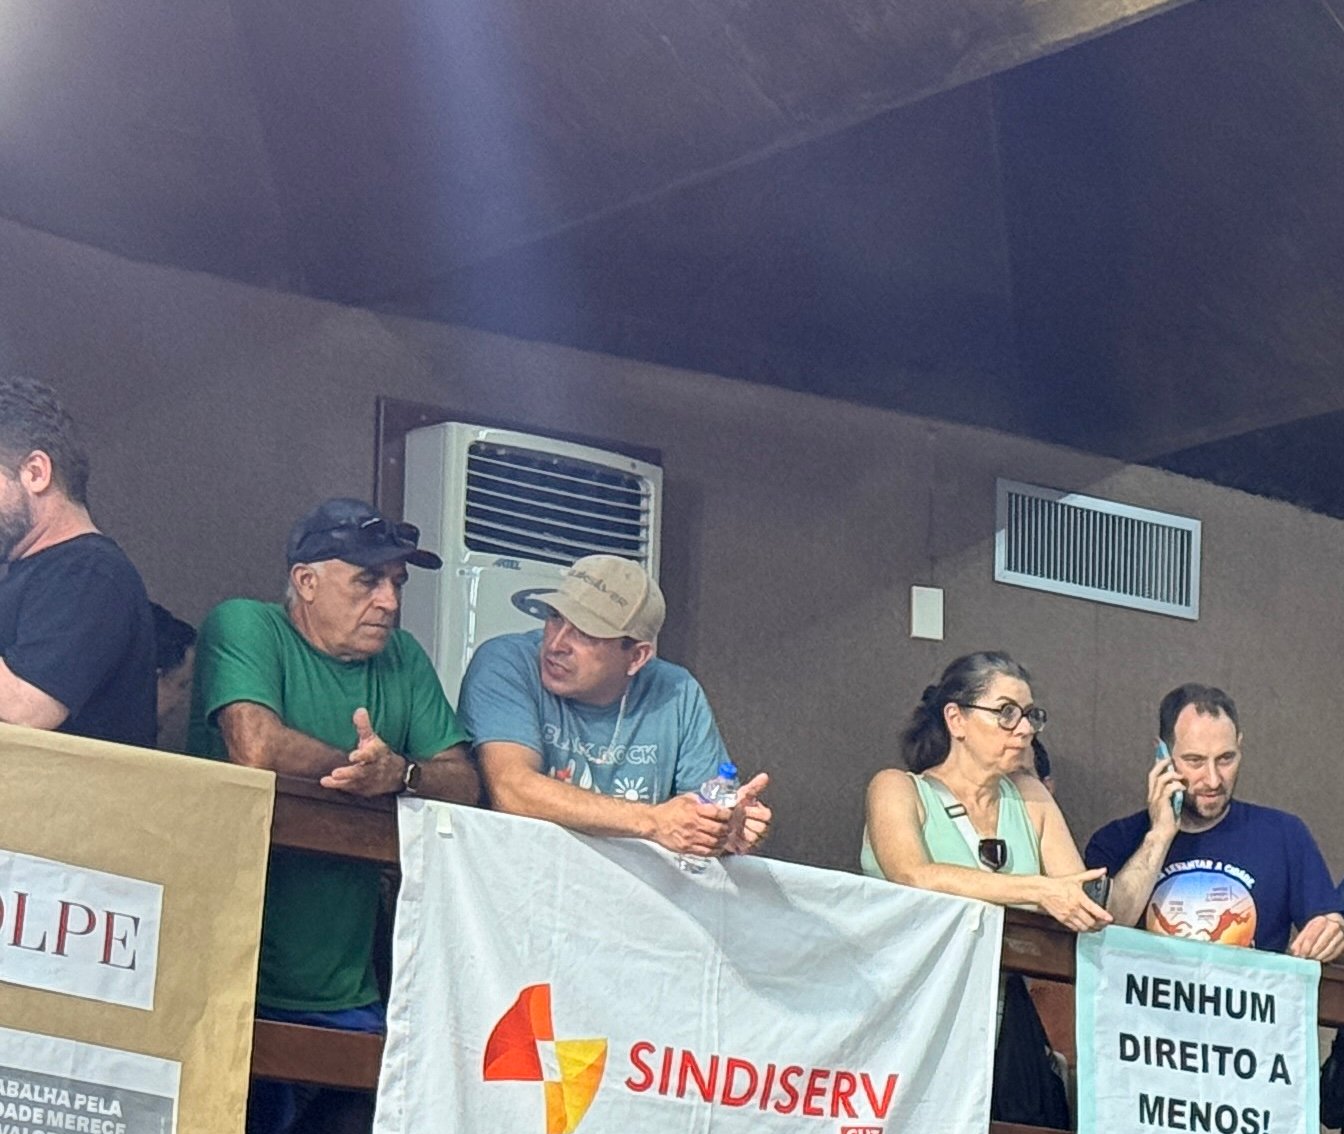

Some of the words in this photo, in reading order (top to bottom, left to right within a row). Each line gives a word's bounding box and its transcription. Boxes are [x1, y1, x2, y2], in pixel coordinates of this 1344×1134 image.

[0, 886, 141, 971] LPE
[1125, 973, 1276, 1024] NENHUM
[626, 1041, 899, 1120] SINDISERV
[1119, 1032, 1257, 1080] DIREITO
[1268, 1053, 1292, 1085] A
[73, 1093, 123, 1118] PELA
